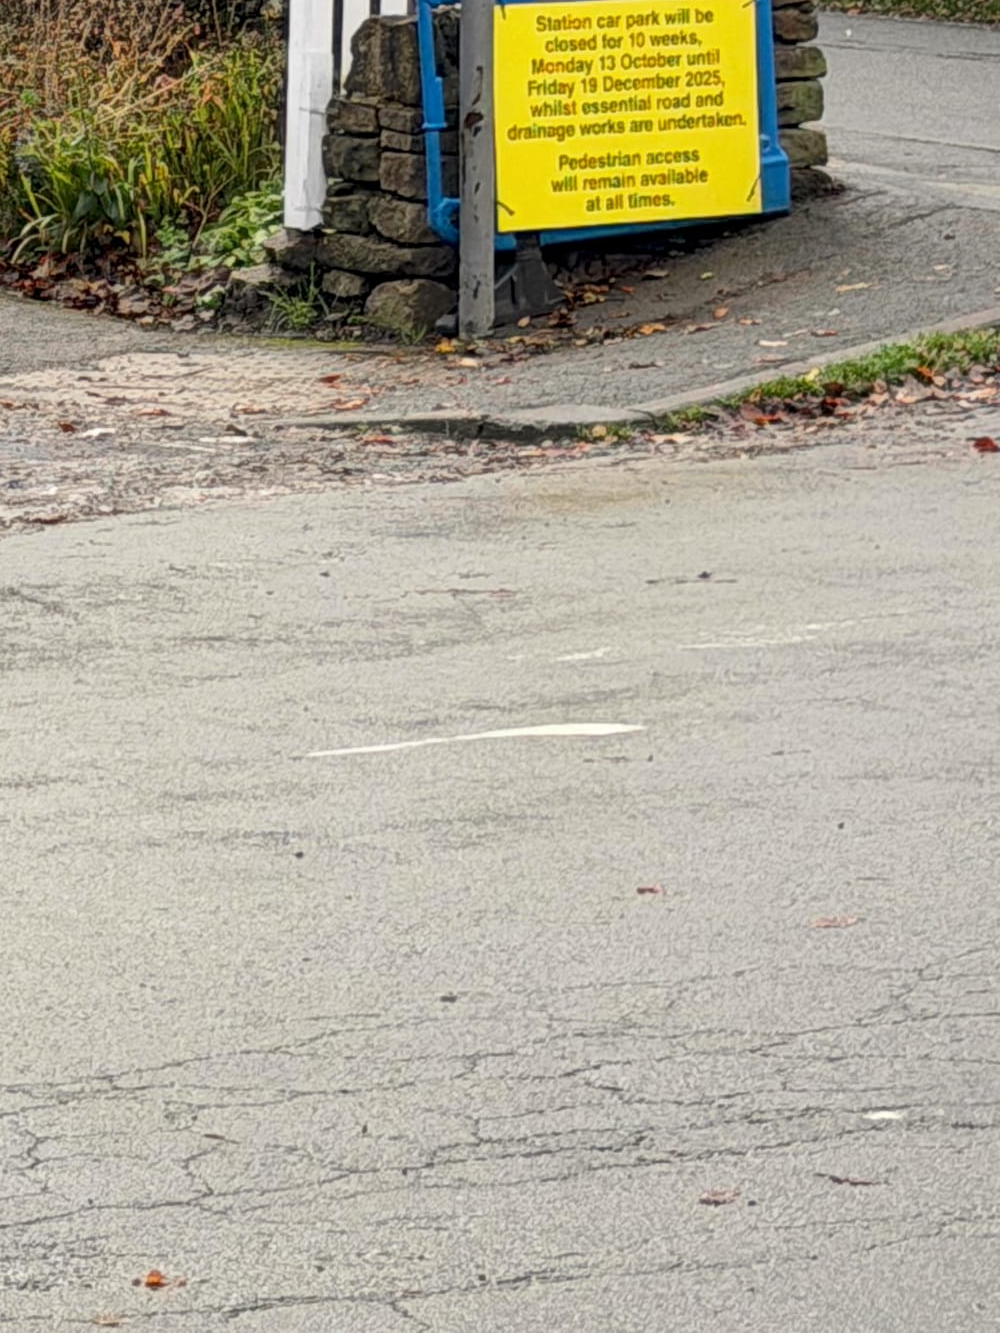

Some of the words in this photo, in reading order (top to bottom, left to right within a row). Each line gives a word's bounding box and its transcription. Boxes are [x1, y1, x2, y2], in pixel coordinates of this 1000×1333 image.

[536, 14, 592, 33] Station
[596, 16, 621, 30] car
[625, 11, 660, 31] park
[664, 9, 690, 26] will
[695, 9, 714, 24] be
[545, 34, 597, 53] closed
[601, 34, 622, 49] for
[629, 32, 645, 48] 10
[649, 31, 702, 48] weeks,
[531, 57, 593, 77] Monday
[599, 55, 616, 71] 13
[620, 53, 682, 71] October
[686, 49, 720, 66] until
[527, 78, 575, 99] Friday
[581, 77, 597, 93] 19
[603, 73, 681, 93] December
[685, 71, 726, 88] 2025,
[530, 100, 577, 117] whilst
[581, 95, 652, 115] essential
[656, 93, 691, 110] road
[695, 90, 724, 107] and
[507, 122, 575, 142] drainage
[579, 119, 625, 136] works
[629, 119, 653, 132] are
[658, 112, 747, 131] undertaken.
[558, 151, 641, 171] Pedestrian
[646, 148, 700, 165] access
[551, 176, 577, 193] will
[582, 172, 636, 191] remain
[640, 168, 709, 187] available
[585, 197, 601, 213] at
[605, 194, 624, 210] all
[628, 192, 675, 209] times.
